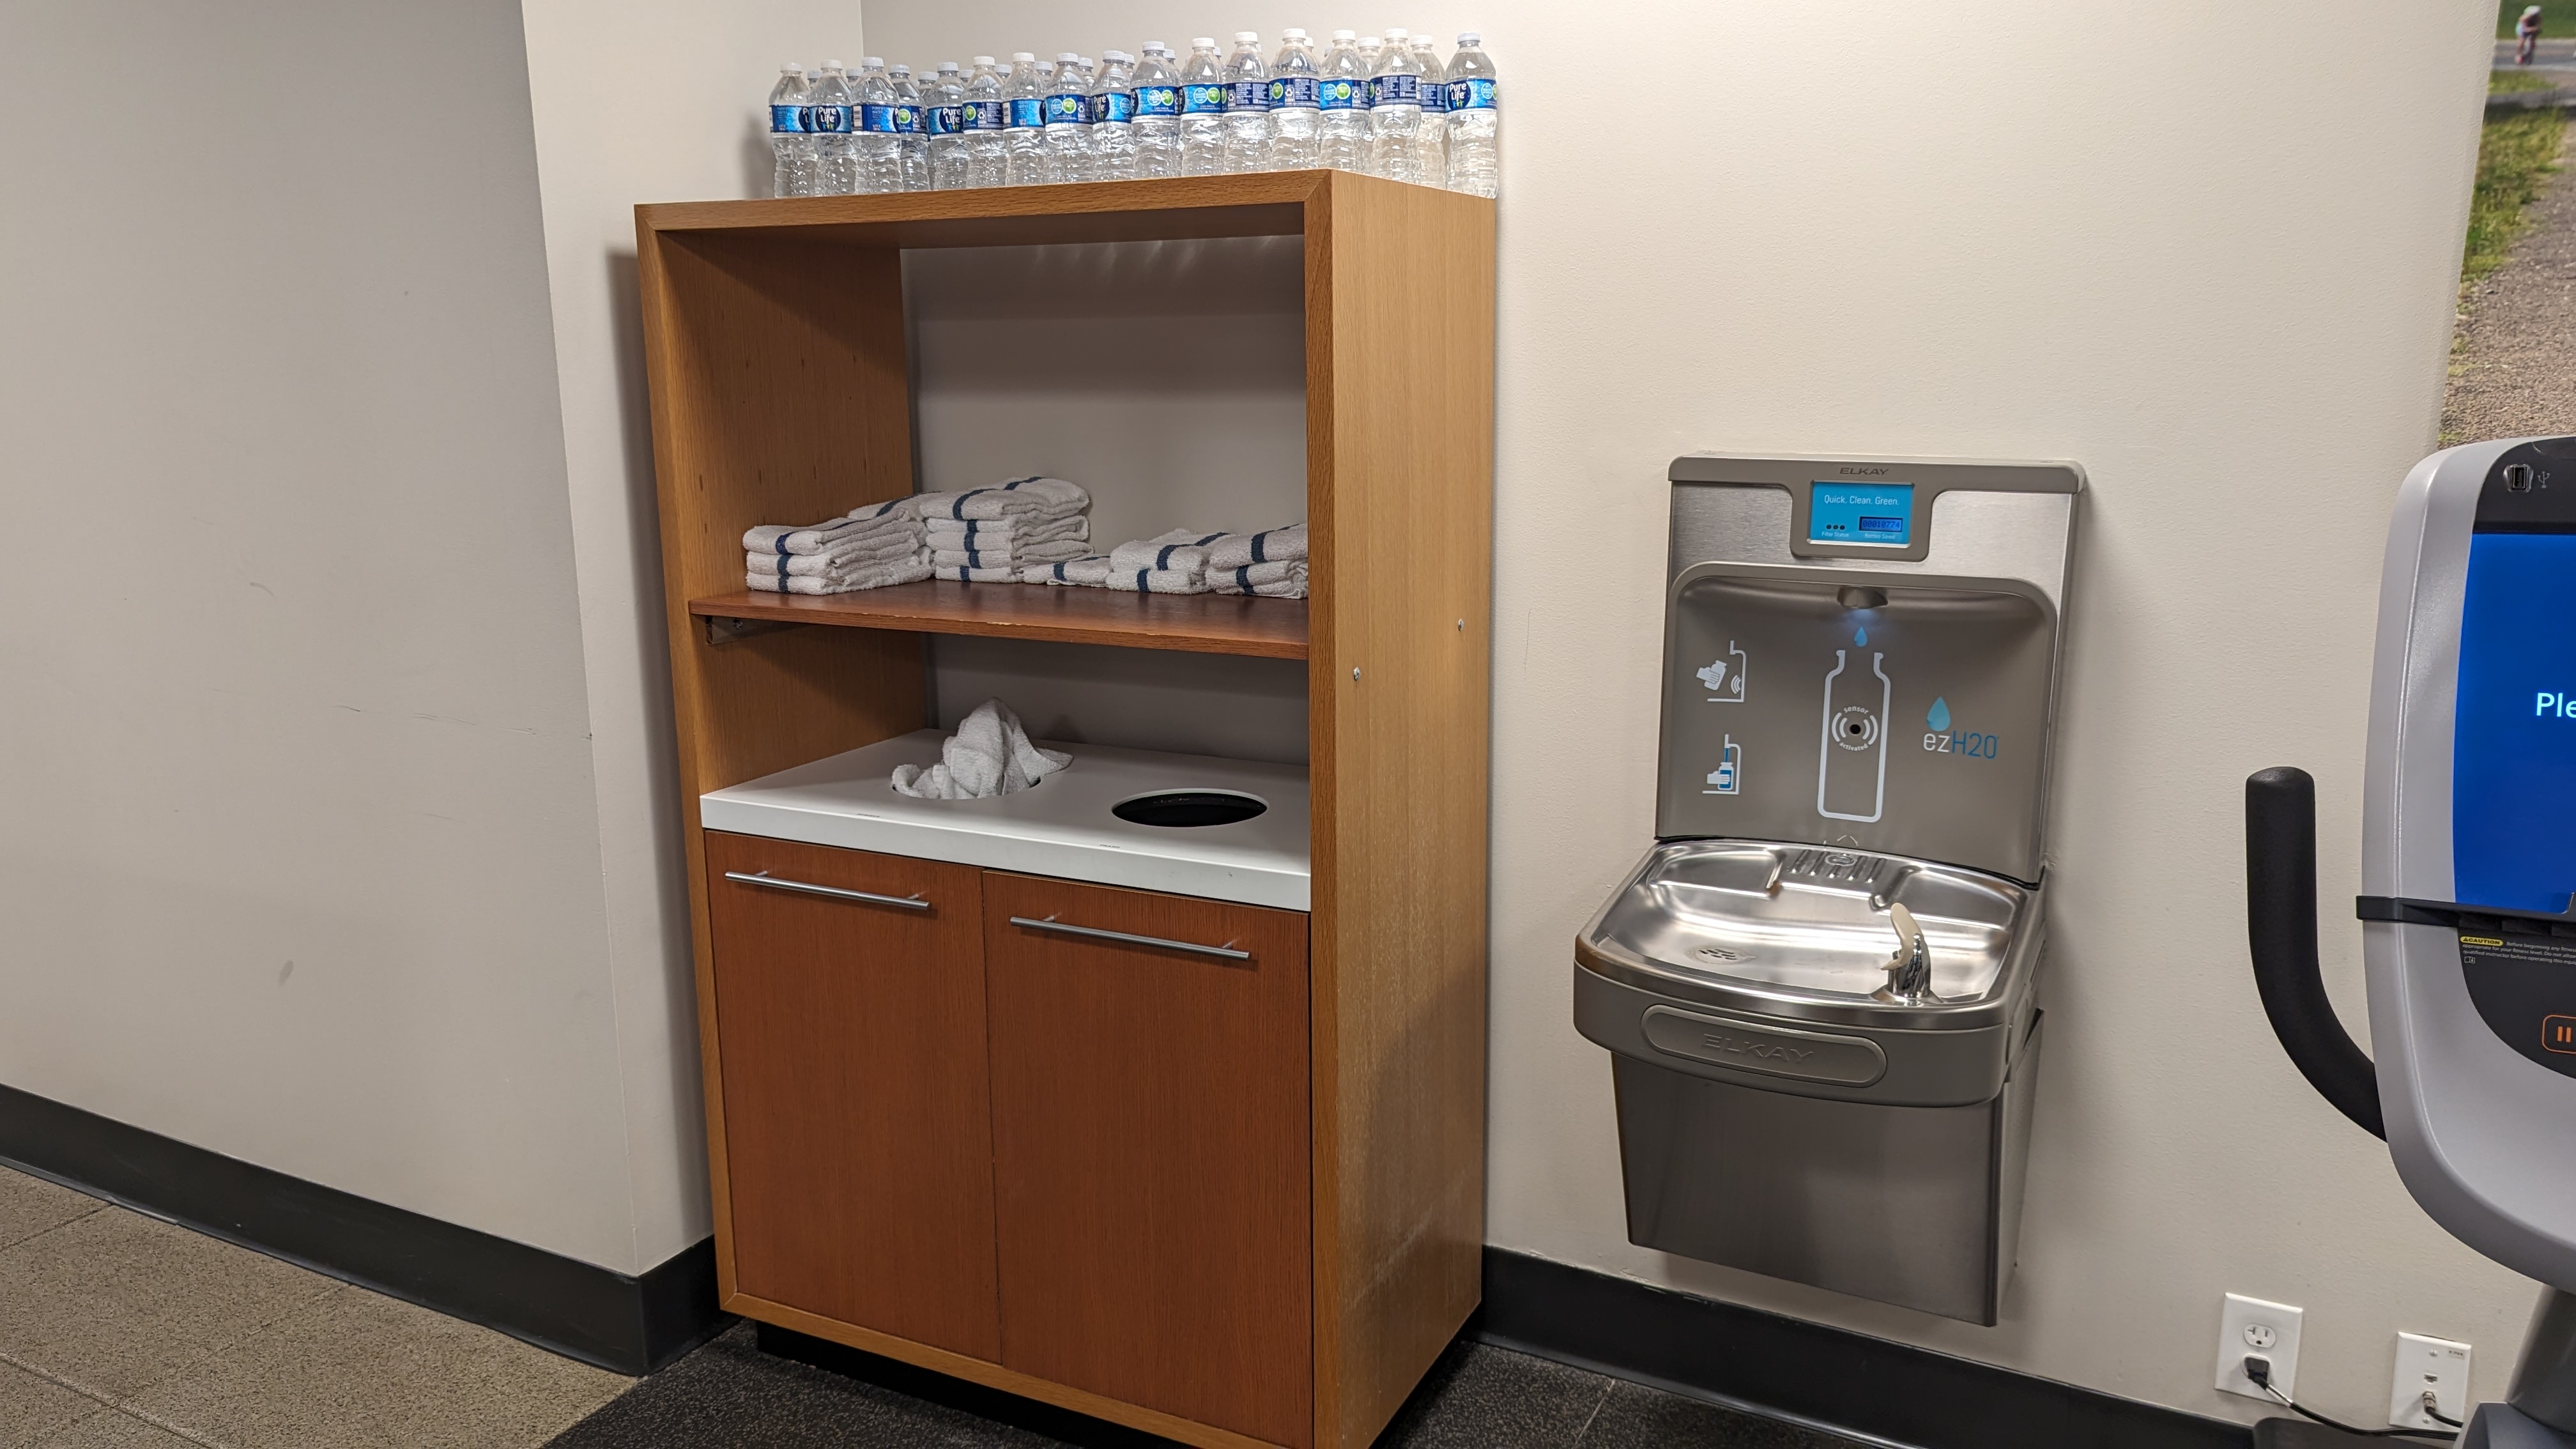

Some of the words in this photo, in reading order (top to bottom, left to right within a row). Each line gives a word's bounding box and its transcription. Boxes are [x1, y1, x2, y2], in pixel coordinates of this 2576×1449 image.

[1450, 83, 1467, 92] Pure
[1093, 96, 1107, 104] Pure
[1451, 91, 1465, 101] Life
[818, 107, 836, 115] Pure
[942, 107, 962, 116] Pure
[1094, 103, 1105, 113] Life
[820, 114, 834, 123] Life
[946, 115, 960, 125] Life
[1824, 494, 1847, 504] Quick.
[1849, 496, 1873, 505] Clean.
[1874, 496, 1899, 505] Green.
[1862, 520, 1900, 529] 00010774
[1844, 706, 1869, 714] sensor
[2536, 692, 2576, 719] Ple
[1839, 742, 1868, 751] activated
[1702, 1033, 1814, 1064] ELKAY
